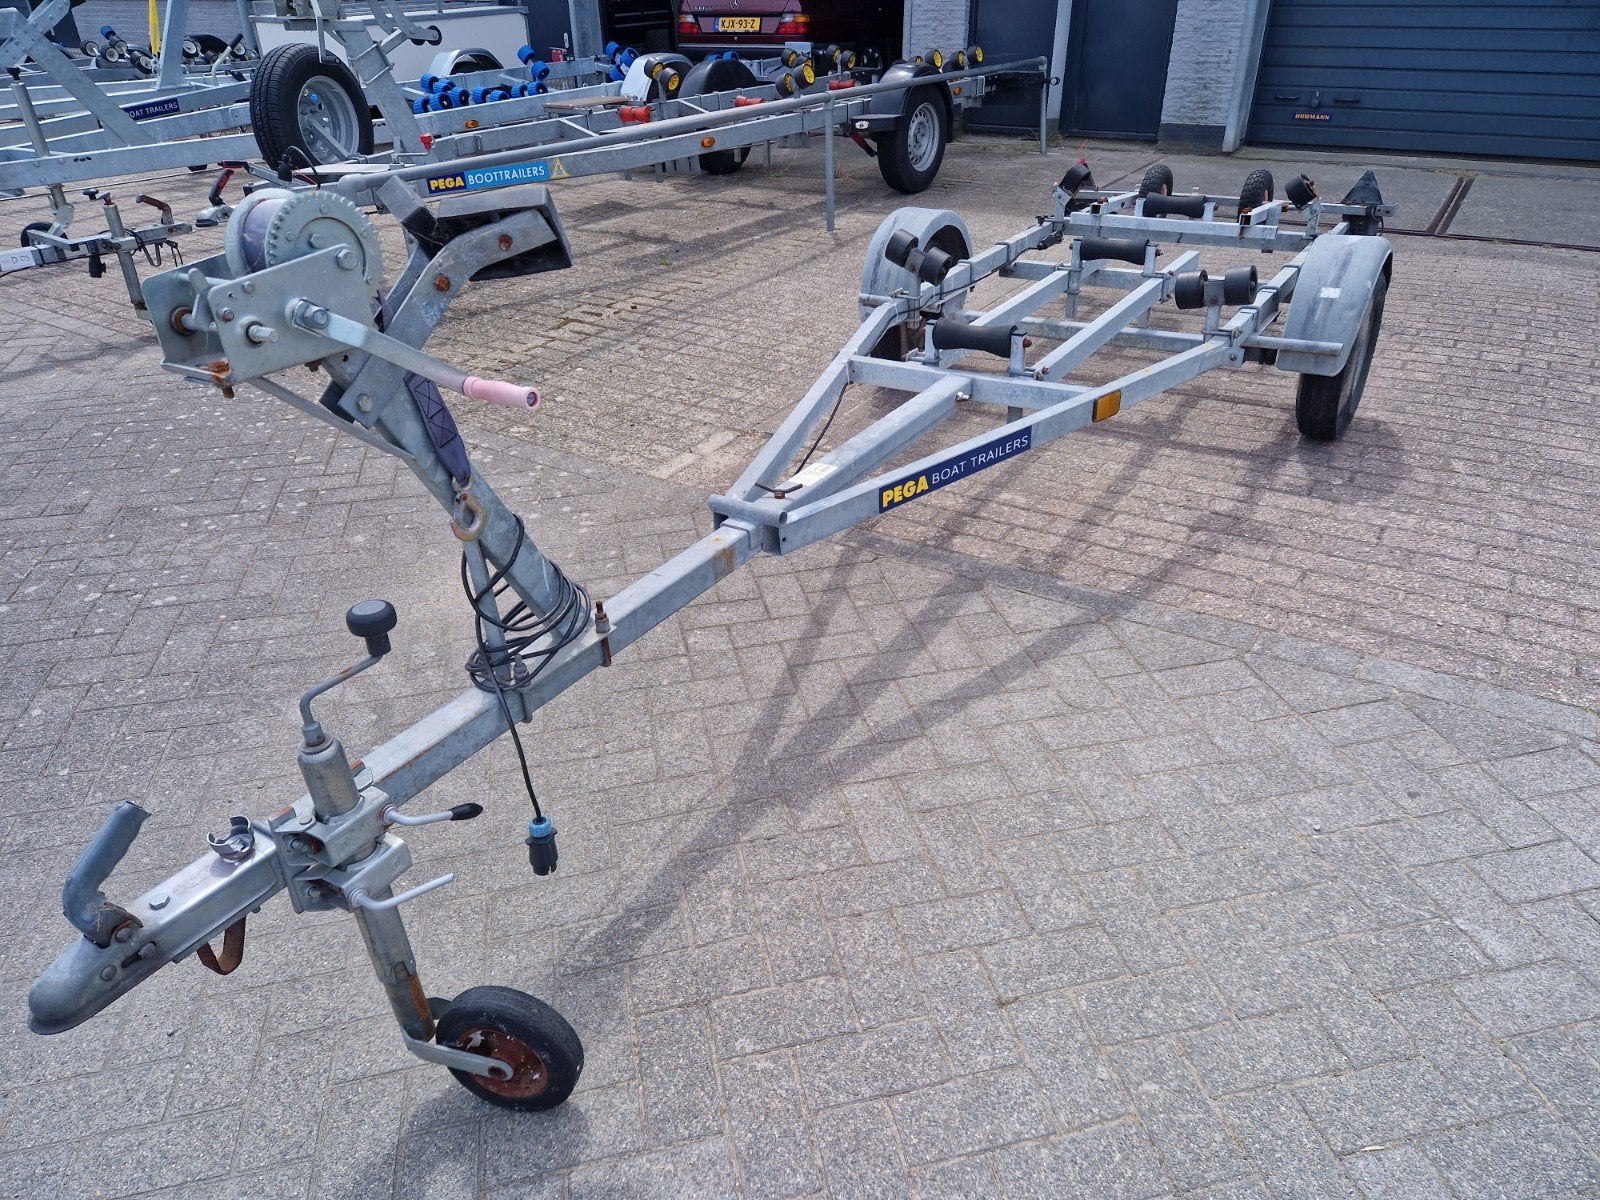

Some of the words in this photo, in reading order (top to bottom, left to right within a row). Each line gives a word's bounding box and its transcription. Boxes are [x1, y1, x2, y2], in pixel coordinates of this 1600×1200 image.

[721, 19, 755, 29] KJX-93-Z
[145, 102, 178, 115] TRAILERS
[430, 176, 465, 191] PEGA
[467, 165, 545, 185] BOOTTRAILERS
[882, 475, 929, 508] PEGA
[932, 461, 967, 485] BOAT
[970, 435, 1028, 468] TRAILERS
